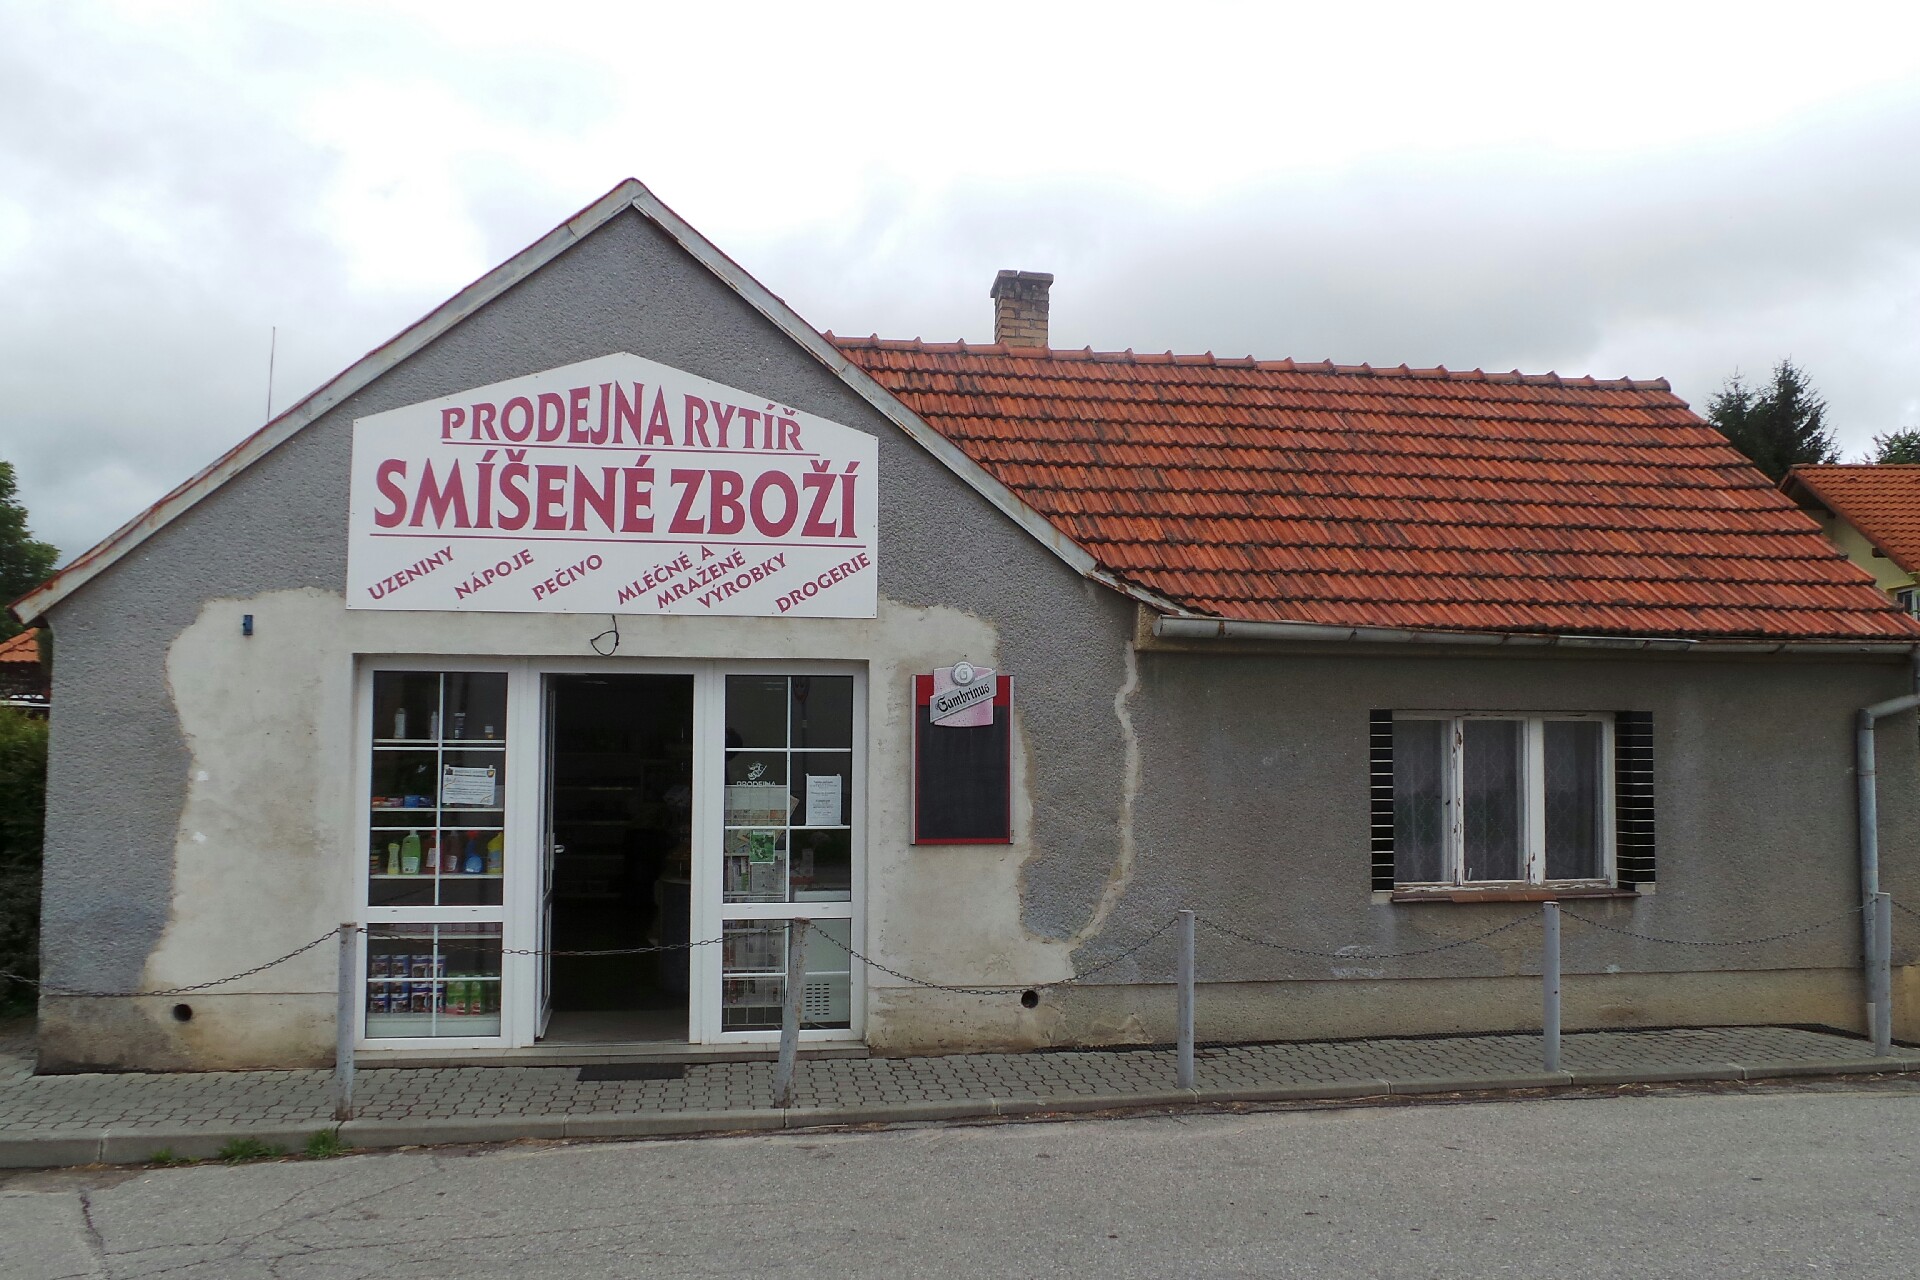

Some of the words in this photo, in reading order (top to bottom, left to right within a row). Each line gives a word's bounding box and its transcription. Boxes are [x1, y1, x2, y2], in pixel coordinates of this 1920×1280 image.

[440, 380, 675, 447] PRODEJNA
[684, 394, 803, 451] RYTÍŘ
[374, 448, 656, 534] SMÍŠENÉ
[669, 459, 860, 540] ZBOŽÍ
[367, 545, 454, 600] UZENINY
[454, 548, 535, 600] NÁPOJE
[531, 554, 604, 601] PEČIVO
[617, 550, 693, 606] MLÉČNÉ
[701, 545, 715, 562] A
[656, 547, 747, 609] MRAŽENÉ
[697, 552, 788, 609] VÝROBKY
[775, 552, 871, 614] DROGERIE
[935, 682, 990, 712] Gambrinus
